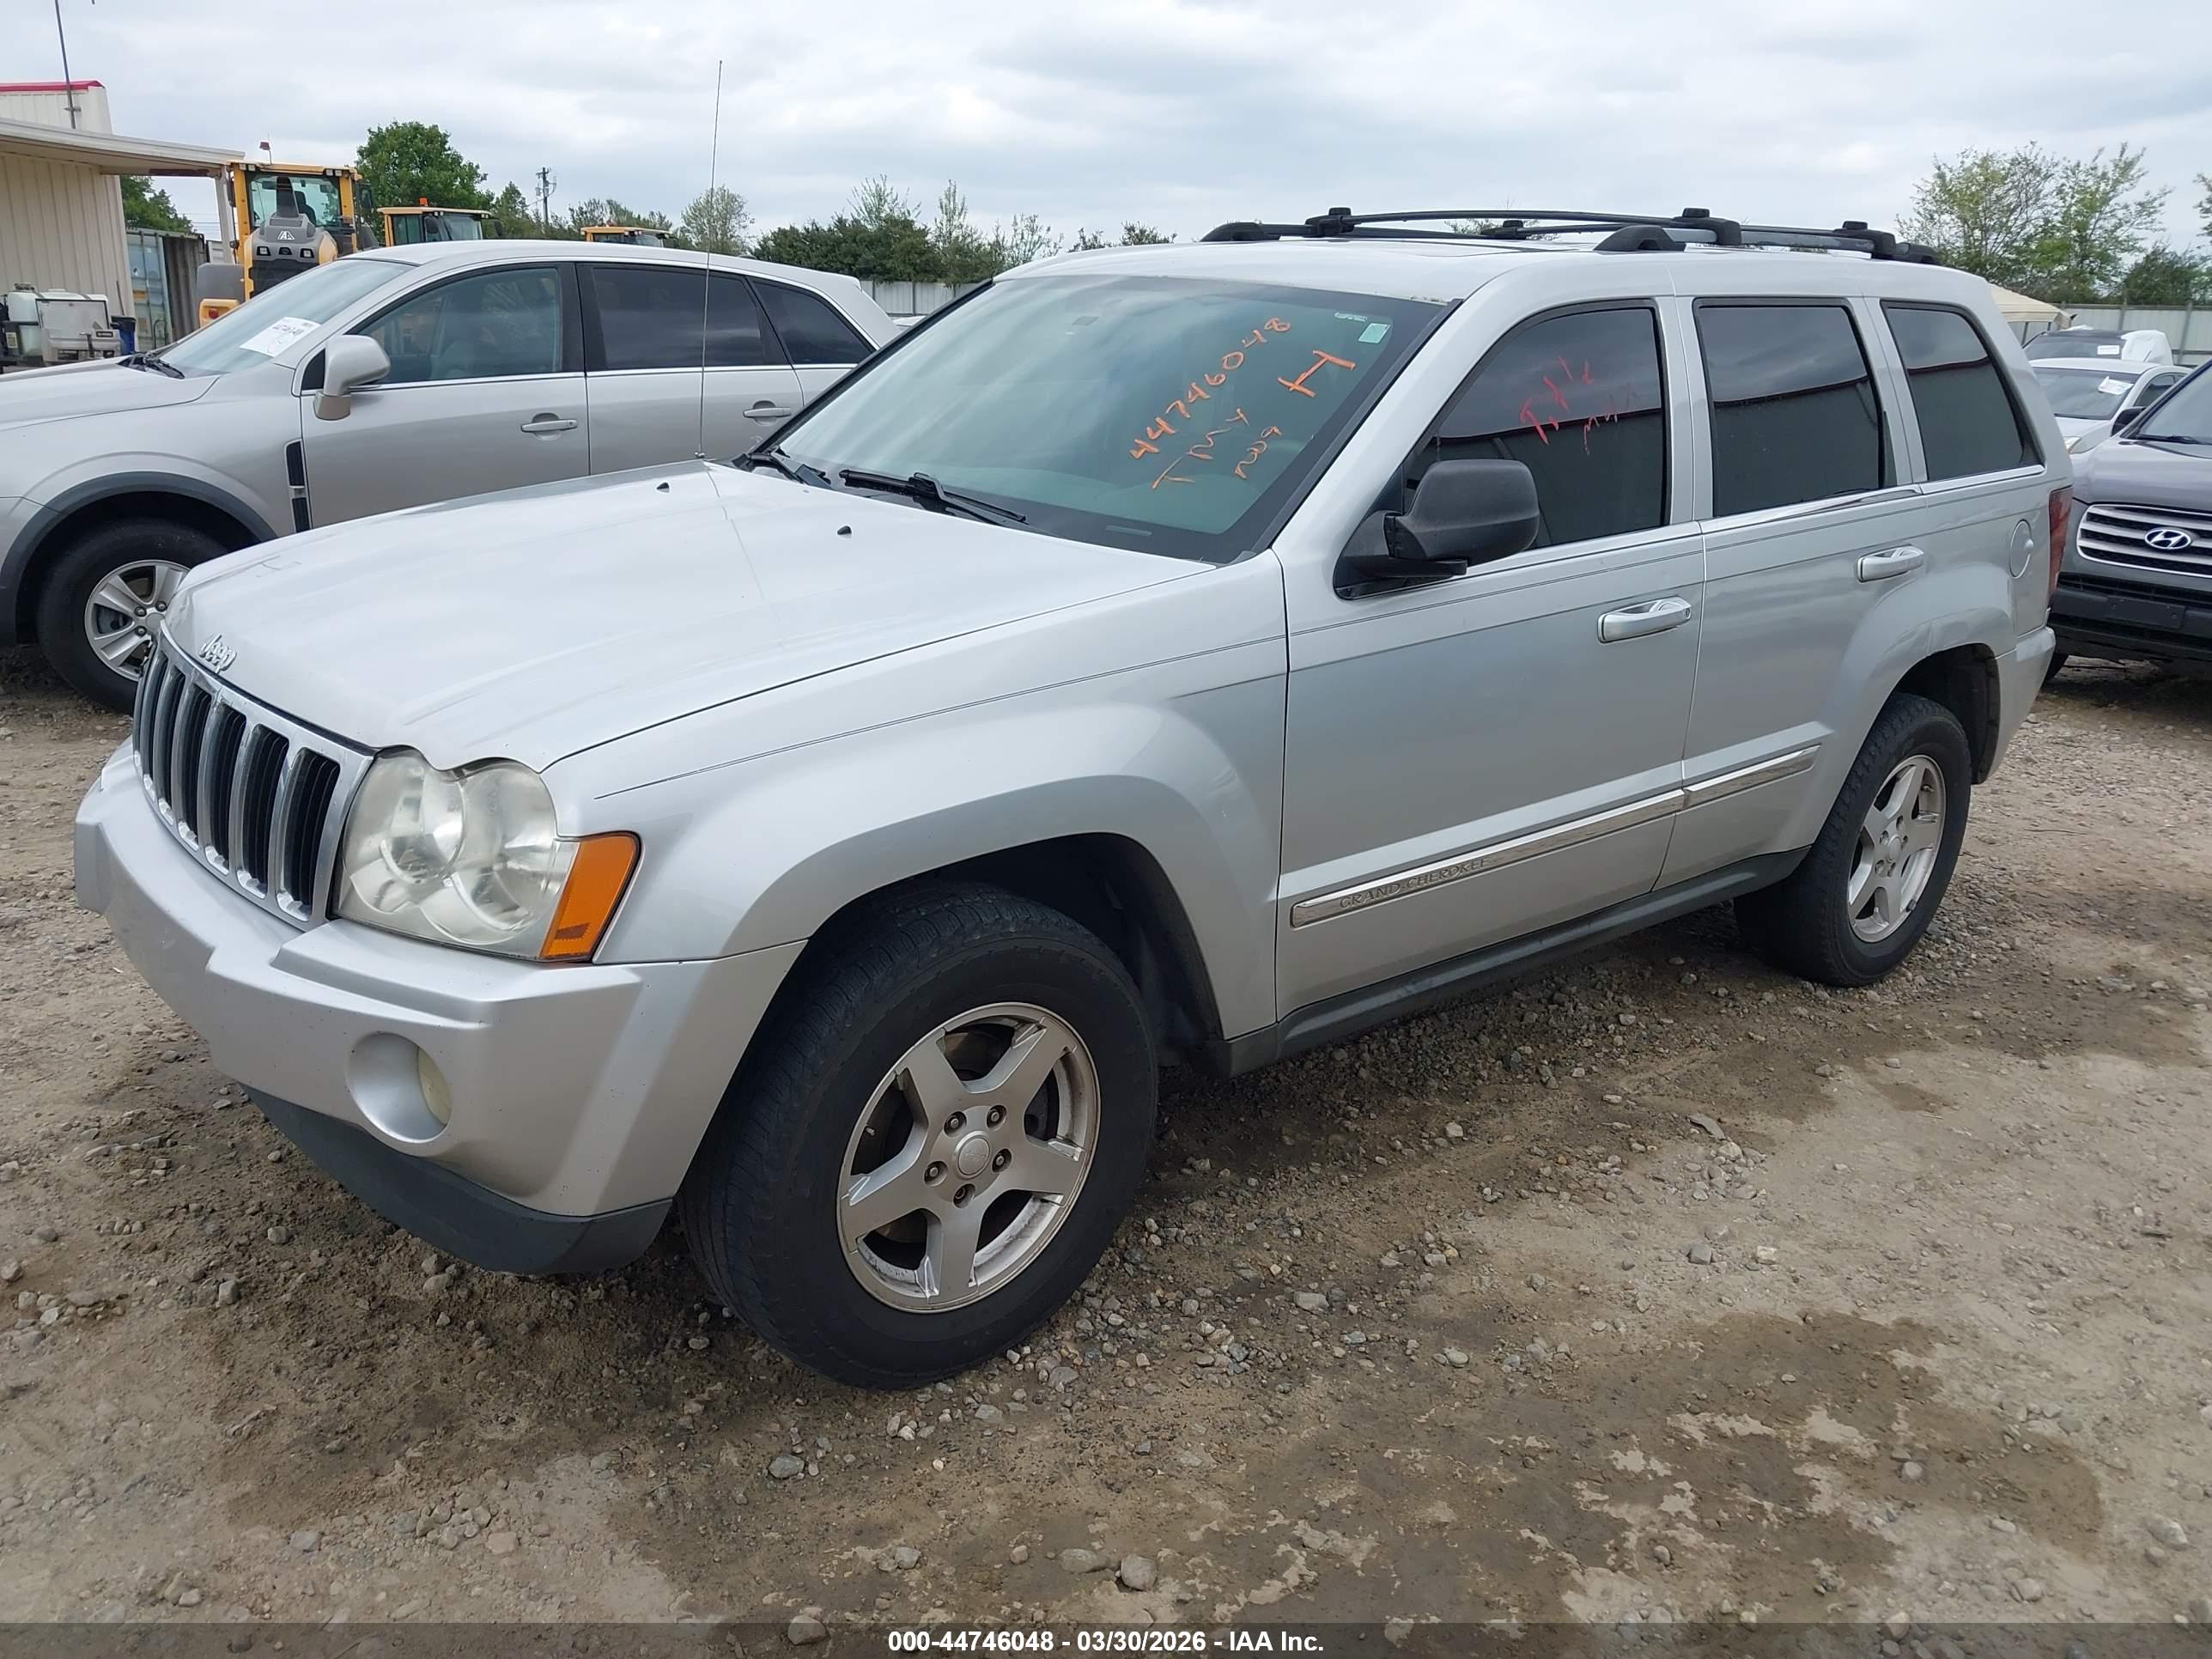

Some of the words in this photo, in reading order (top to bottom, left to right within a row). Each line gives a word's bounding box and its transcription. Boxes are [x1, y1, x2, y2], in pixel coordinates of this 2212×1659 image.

[1129, 317, 1291, 459] 44746048
[198, 634, 237, 675] Jeep
[1340, 884, 1401, 908] GRAND
[1407, 857, 1491, 890] CHEROKEE
